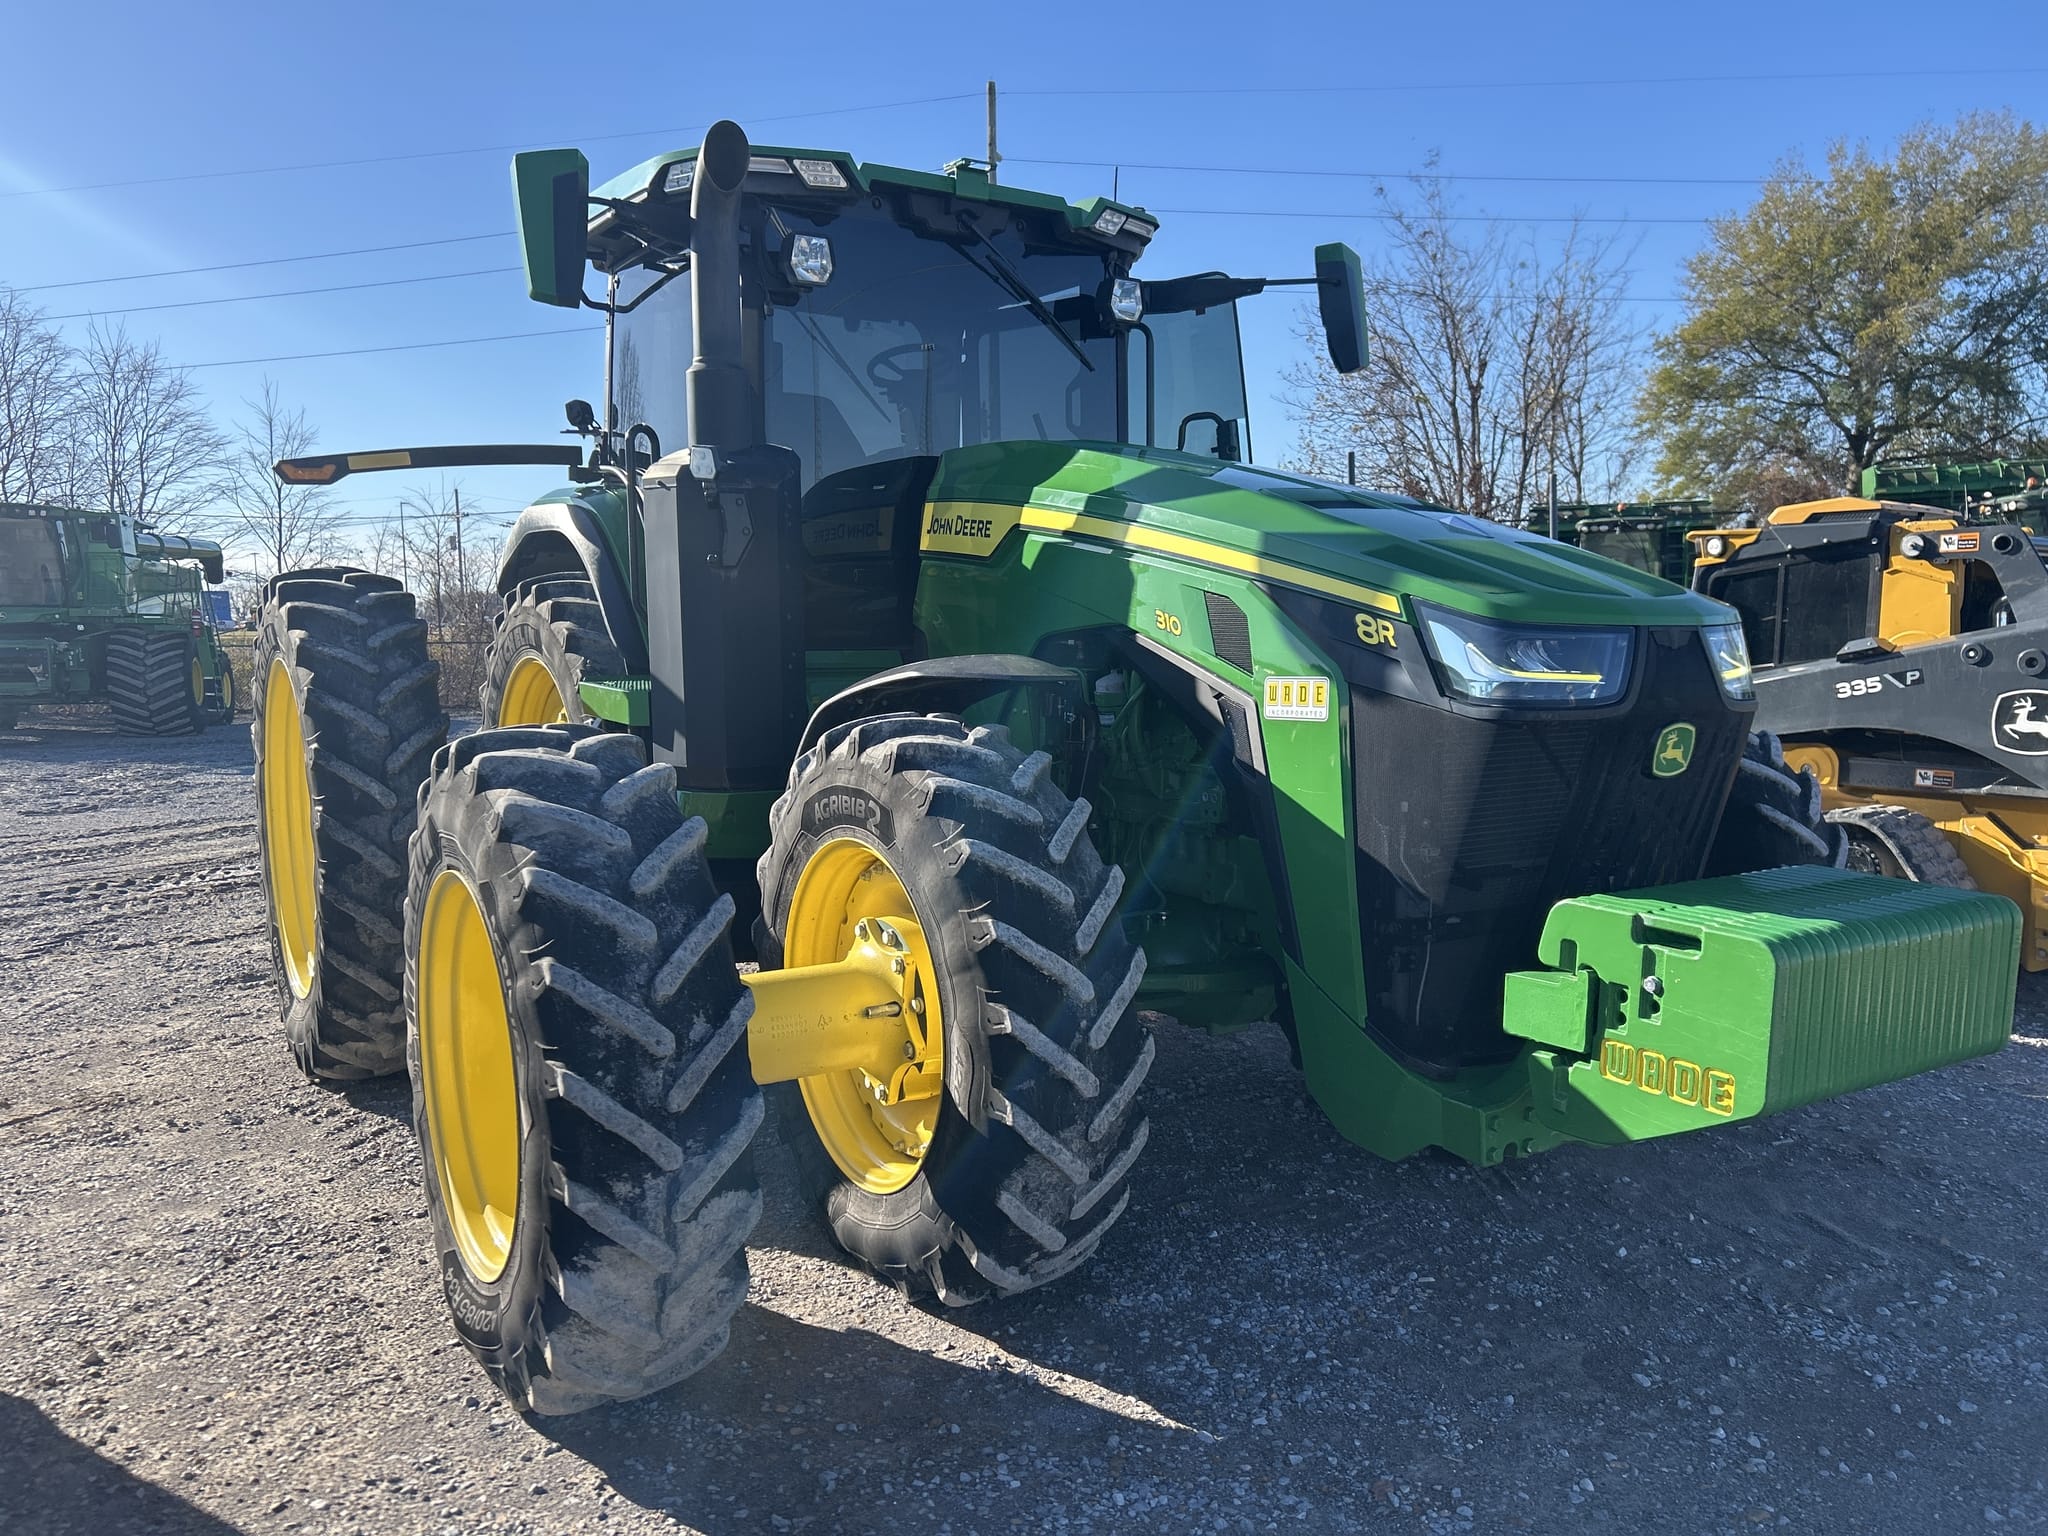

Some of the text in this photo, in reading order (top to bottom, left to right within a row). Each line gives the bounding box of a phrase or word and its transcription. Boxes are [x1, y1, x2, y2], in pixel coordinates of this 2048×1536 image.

[926, 513, 993, 539] JOHN DEERE
[1155, 609, 1182, 636] 310
[1355, 614, 1397, 648] 8R
[1268, 684, 1324, 704] WADE
[1835, 676, 1883, 699] 335
[1268, 709, 1323, 718] INCORPORATED
[814, 794, 866, 825] AGRIBIB
[1600, 1039, 1736, 1116] WADE
